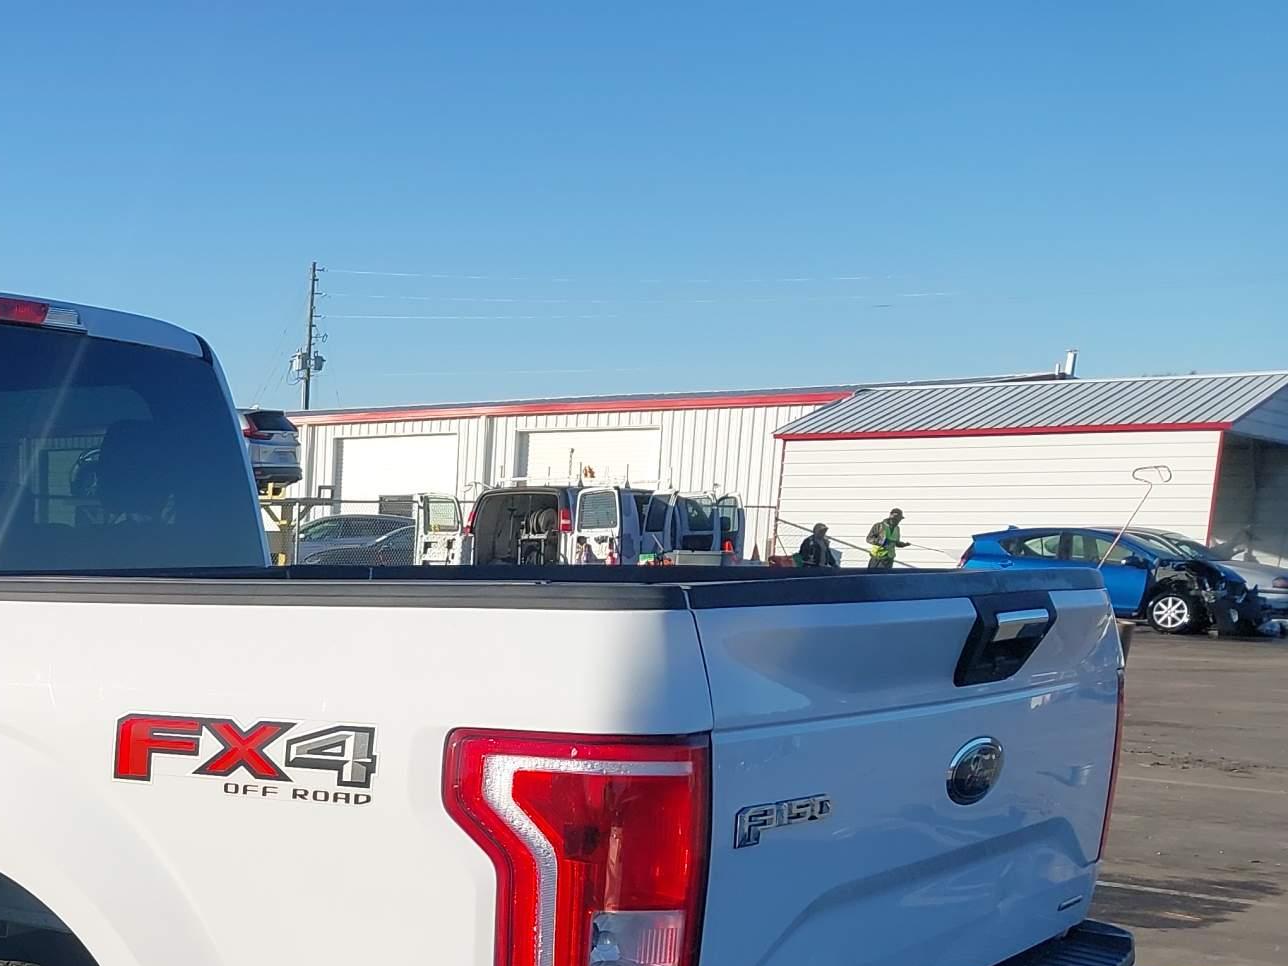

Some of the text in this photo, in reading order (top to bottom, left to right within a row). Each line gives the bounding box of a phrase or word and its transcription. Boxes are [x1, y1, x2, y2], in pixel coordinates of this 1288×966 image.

[113, 713, 376, 788] FX4
[223, 782, 371, 805] OFF ROAD
